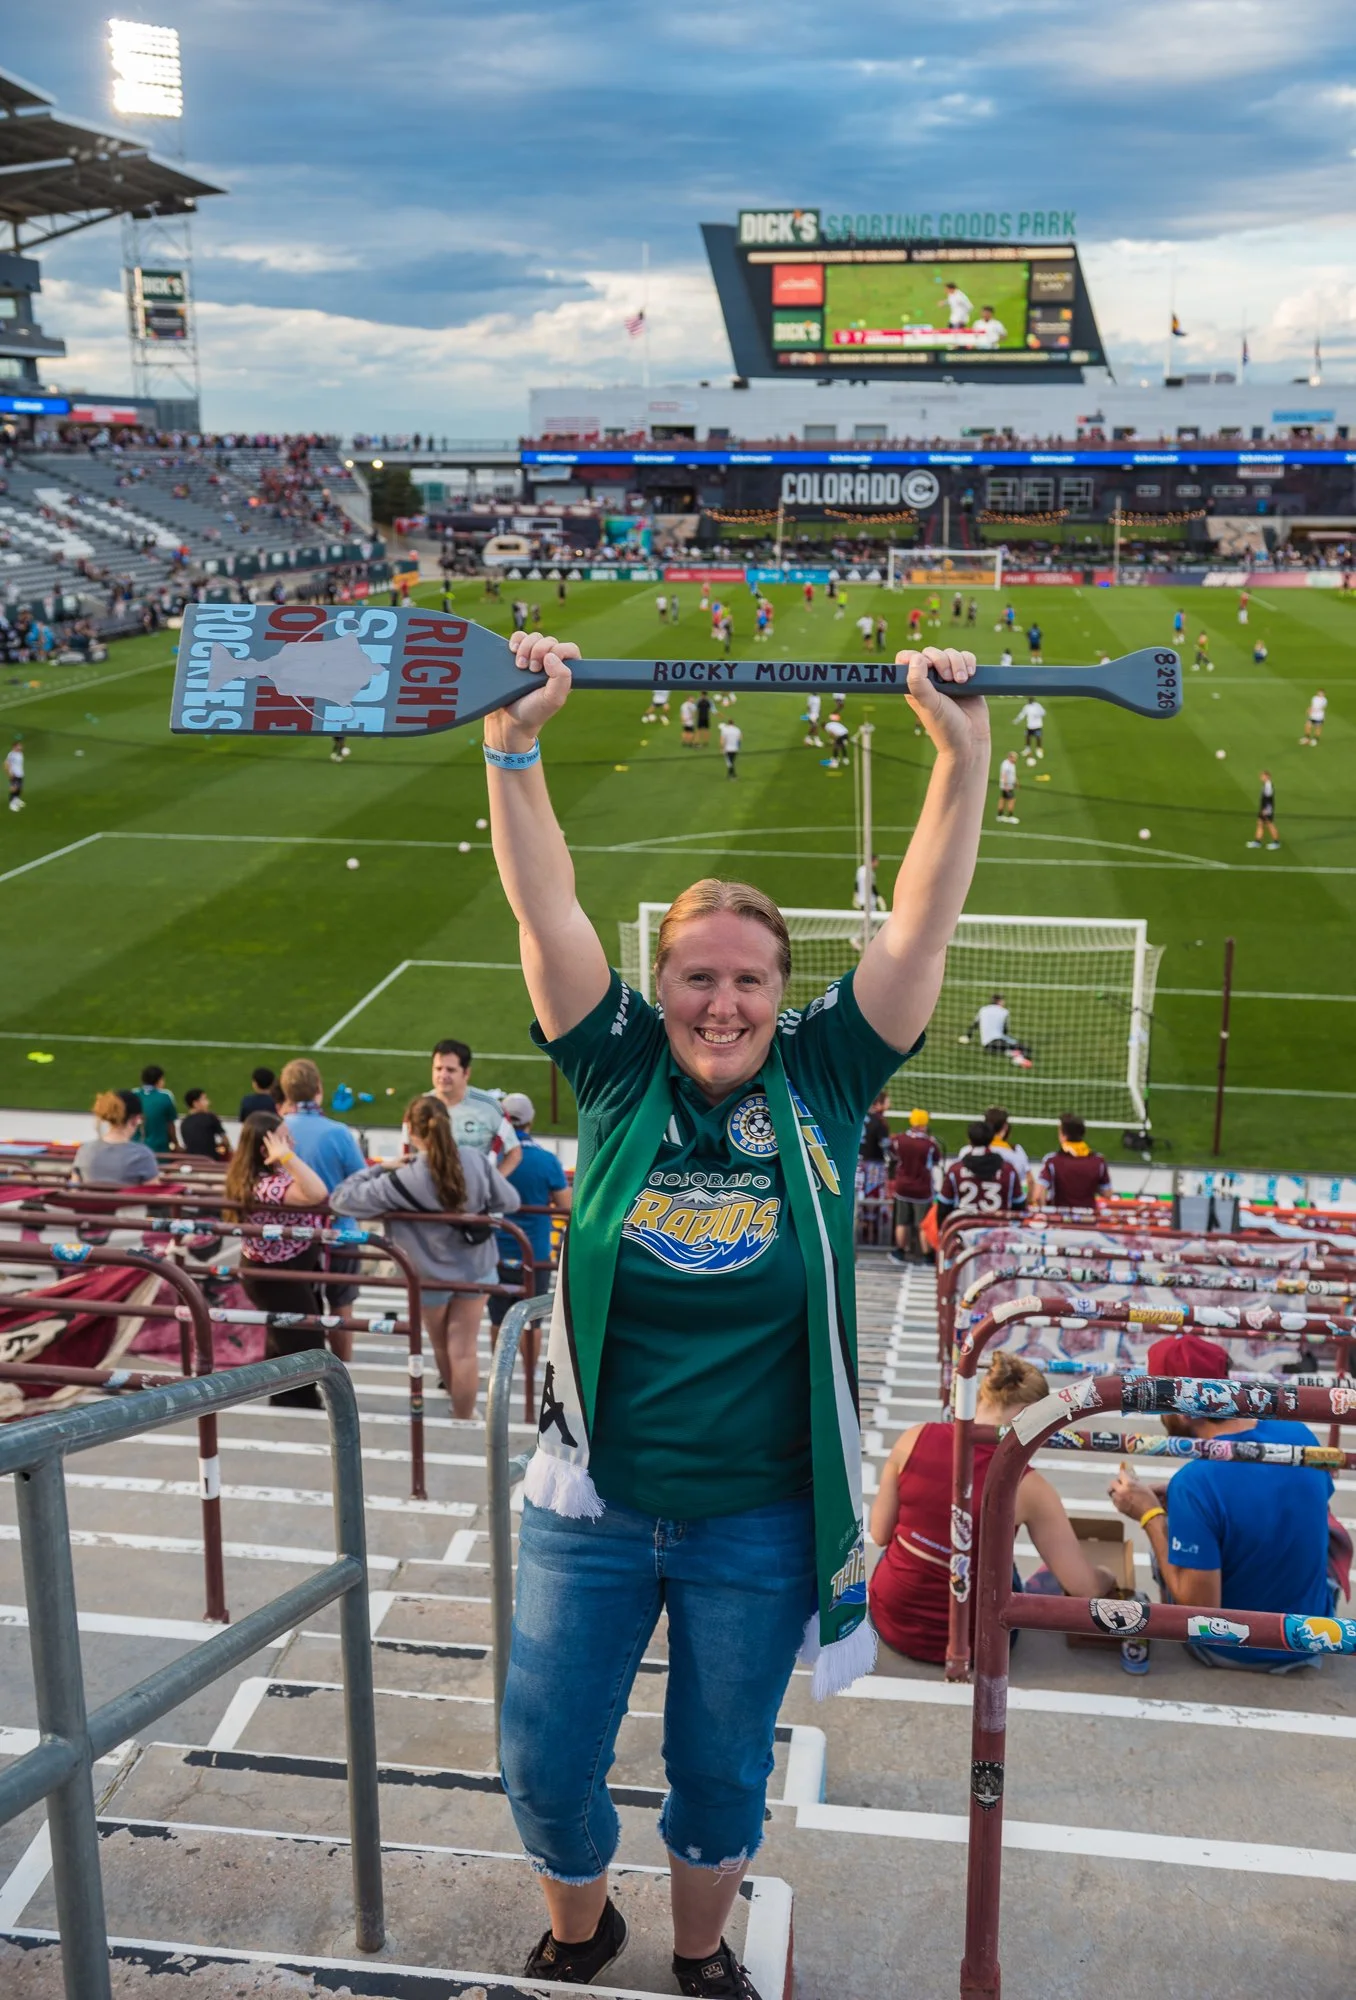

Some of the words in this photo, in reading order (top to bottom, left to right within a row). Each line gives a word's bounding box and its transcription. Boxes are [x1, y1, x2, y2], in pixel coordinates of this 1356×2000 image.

[741, 211, 818, 243] DICK'S
[826, 213, 932, 241] SPORTING
[939, 212, 1011, 239] GOODS
[1018, 210, 1077, 237] PARK
[782, 472, 901, 505] COLORADO
[396, 618, 469, 728] RIGHT
[653, 661, 738, 681] ROCKY
[755, 662, 897, 683] MOUNTAIN
[731, 1097, 769, 1131] COLOR
[739, 1138, 778, 1152] RAPI
[648, 1171, 771, 1189] COLORADO
[958, 1180, 1002, 1212] 23
[624, 1188, 781, 1246] RAPIDS
